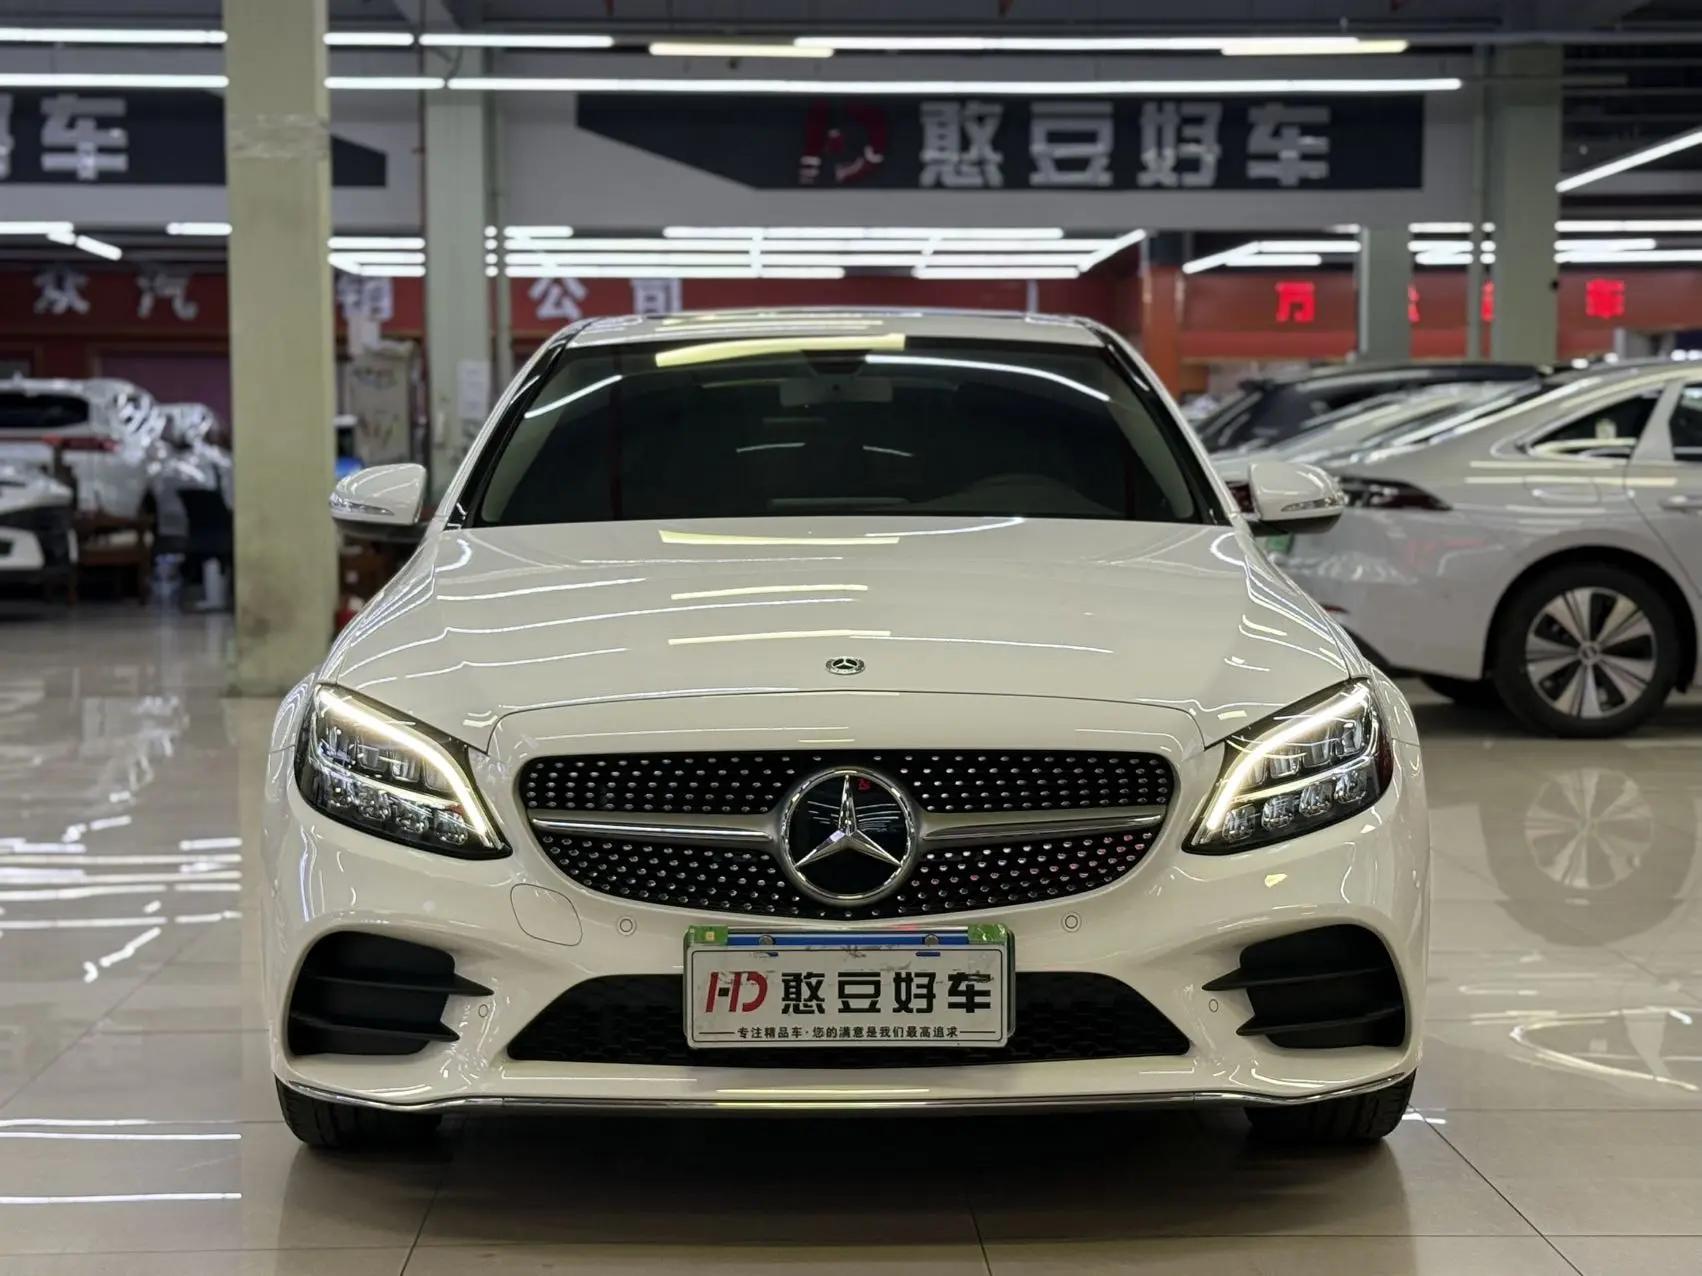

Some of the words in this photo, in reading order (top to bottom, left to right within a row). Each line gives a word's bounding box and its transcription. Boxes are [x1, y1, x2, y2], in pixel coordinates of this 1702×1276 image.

[0, 93, 128, 181] 车
[920, 101, 1331, 188] 憨豆好车
[705, 970, 768, 1014] HD
[781, 971, 992, 1015] 憨豆好车
